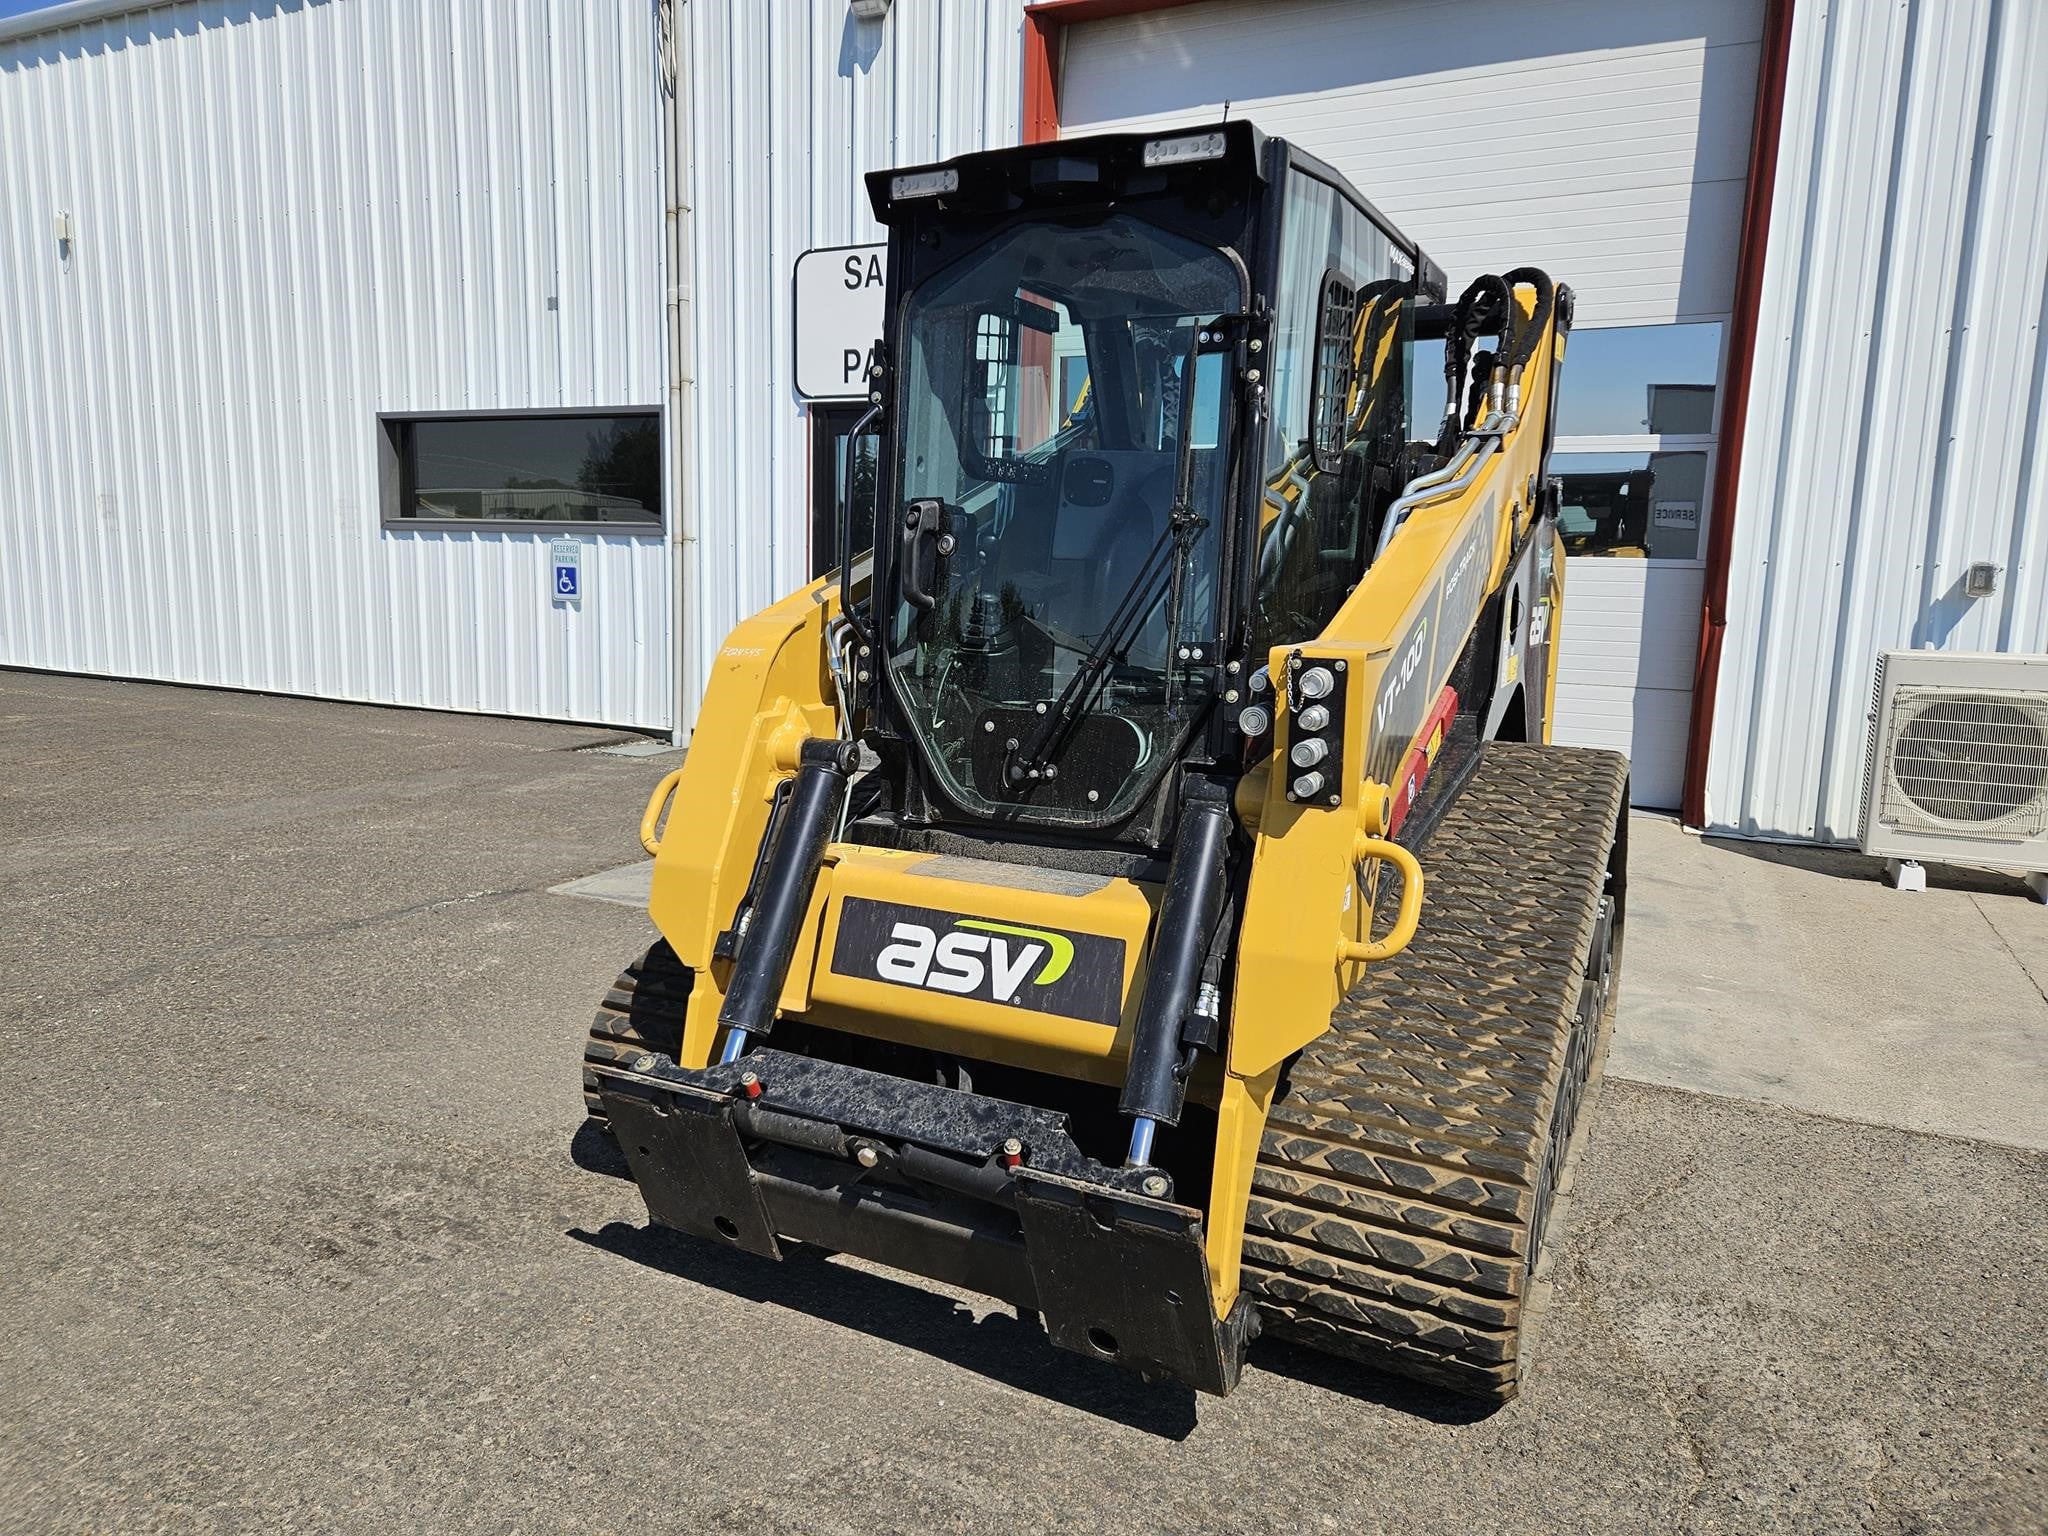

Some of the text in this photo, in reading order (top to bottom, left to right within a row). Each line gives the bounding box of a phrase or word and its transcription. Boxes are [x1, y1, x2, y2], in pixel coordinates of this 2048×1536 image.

[553, 544, 578, 554] RESERVED
[555, 555, 577, 564] PARKING
[1377, 629, 1424, 733] VT-100
[876, 921, 1046, 1002] asv
